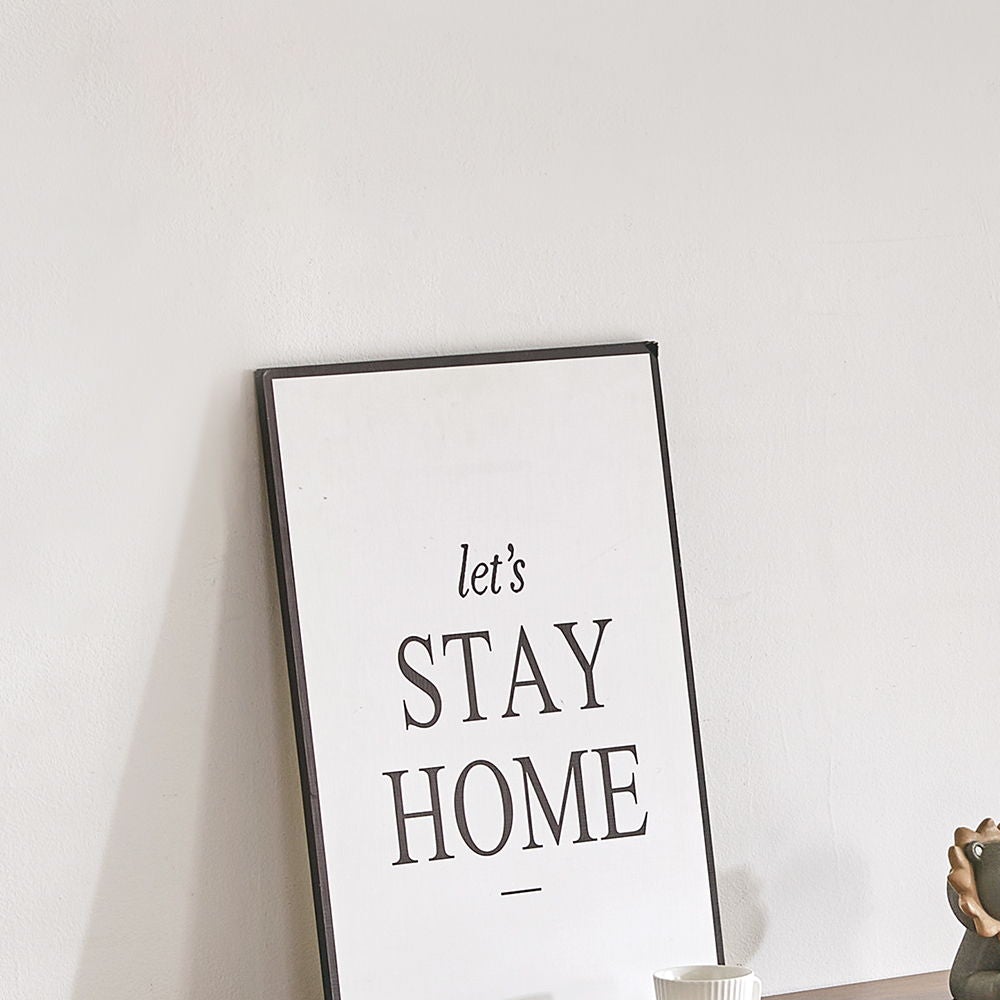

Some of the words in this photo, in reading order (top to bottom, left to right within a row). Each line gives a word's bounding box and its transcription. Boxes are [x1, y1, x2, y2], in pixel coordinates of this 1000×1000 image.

[458, 543, 526, 598] let's
[397, 618, 613, 730] STAY
[382, 744, 648, 866] HOME
